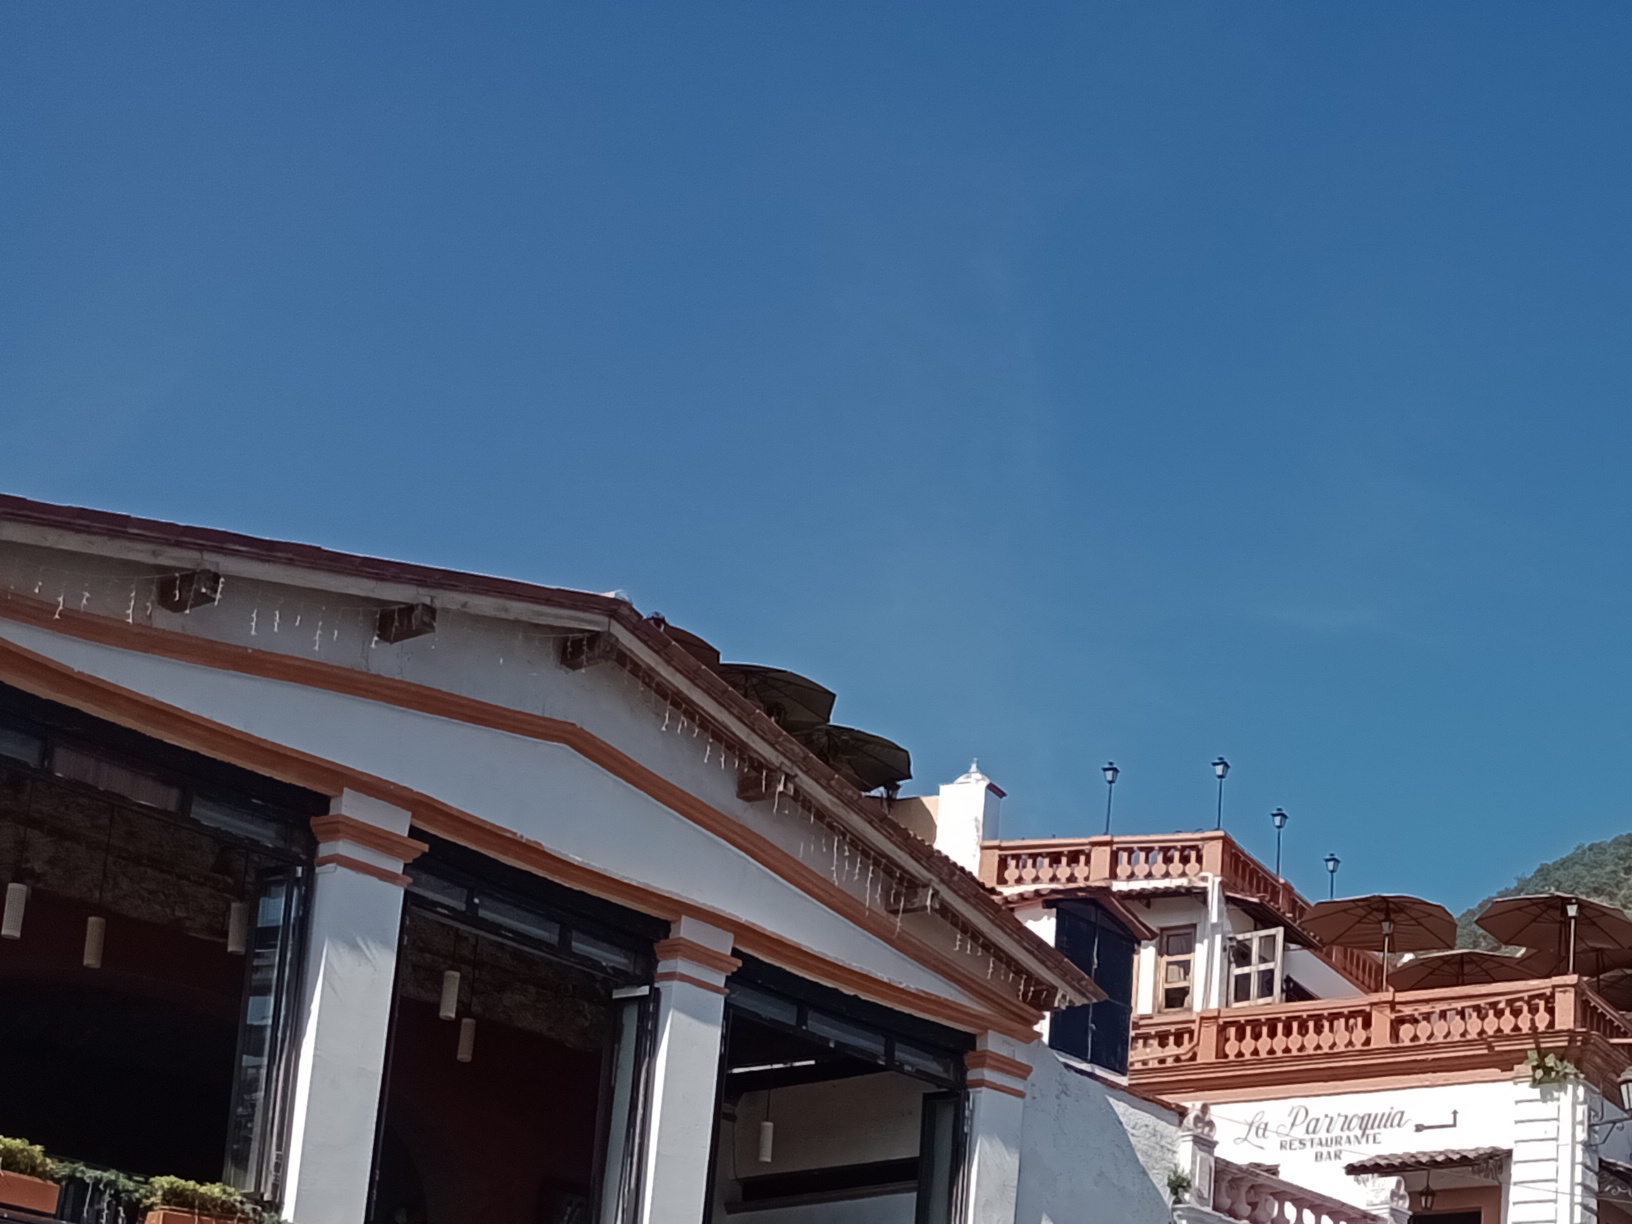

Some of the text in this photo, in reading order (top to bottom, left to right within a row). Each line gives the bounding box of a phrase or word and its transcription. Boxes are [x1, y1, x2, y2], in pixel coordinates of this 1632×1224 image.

[1233, 1105, 1412, 1150] La Parroquia
[1279, 1132, 1382, 1151] RESTAURANTE
[1314, 1150, 1343, 1163] BAR
